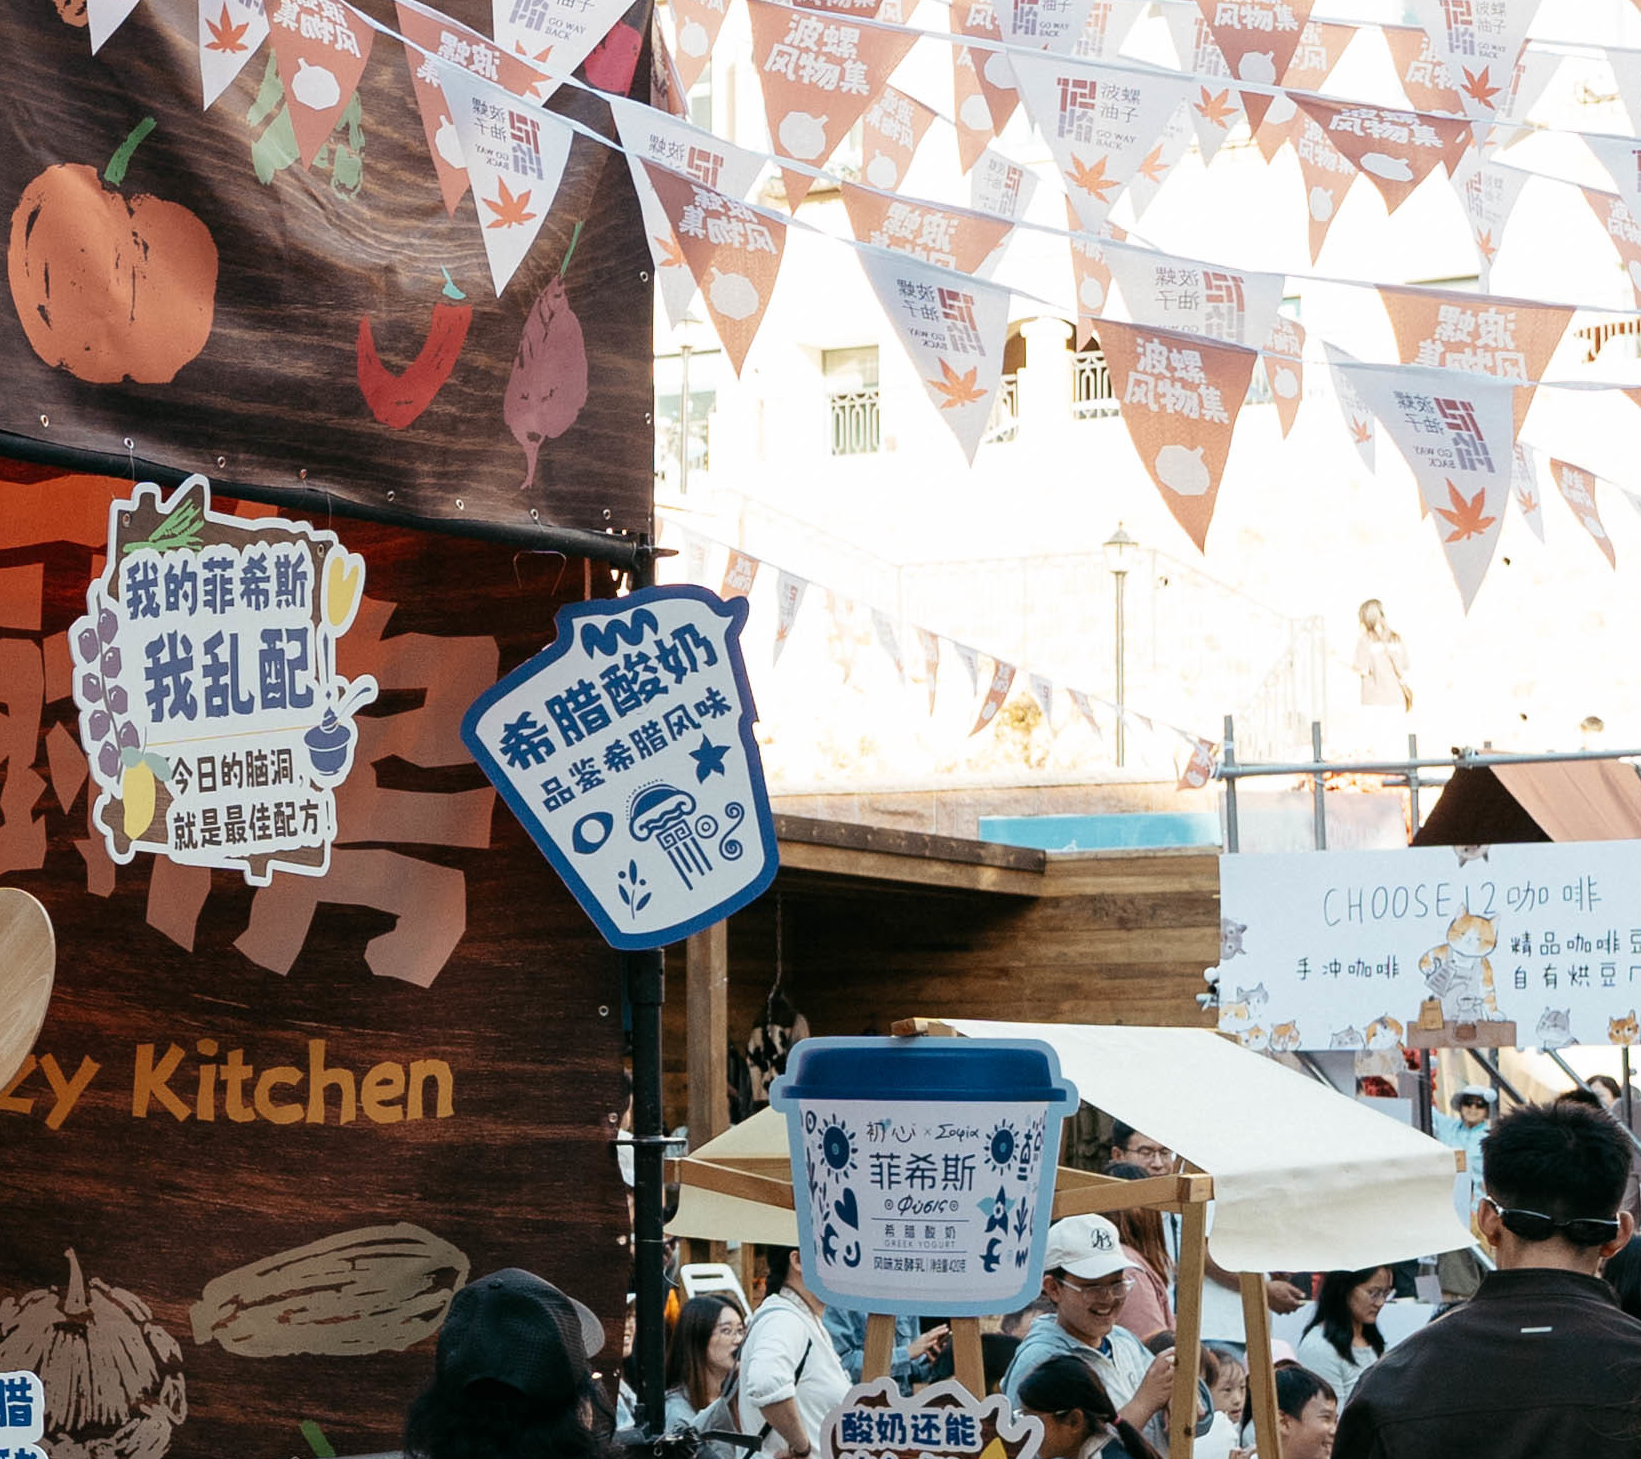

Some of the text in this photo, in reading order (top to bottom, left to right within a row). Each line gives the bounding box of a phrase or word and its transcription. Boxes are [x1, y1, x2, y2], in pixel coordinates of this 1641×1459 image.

[545, 26, 571, 41] BACK
[548, 17, 588, 35] GO WAY
[784, 15, 860, 59] 波螺
[1214, 4, 1300, 34] 风物集
[764, 44, 869, 95] 风物集
[1137, 338, 1208, 383] 波螺
[1123, 371, 1230, 424] 风物集
[126, 552, 308, 620] 我的菲希斯
[144, 627, 314, 723] 我乱配
[500, 623, 717, 771] 希腊酸奶
[541, 687, 732, 813] 品鉴希腊风味
[1323, 882, 1452, 927] CHOOSE
[1508, 875, 1602, 912] 咖啡
[1296, 956, 1400, 981] 手冲咖啡
[132, 1039, 455, 1127] Kitchen
[869, 1152, 976, 1191] 菲希斯
[885, 1224, 956, 1239] 希腊酸奶
[842, 1411, 978, 1446] 酸奶还能
